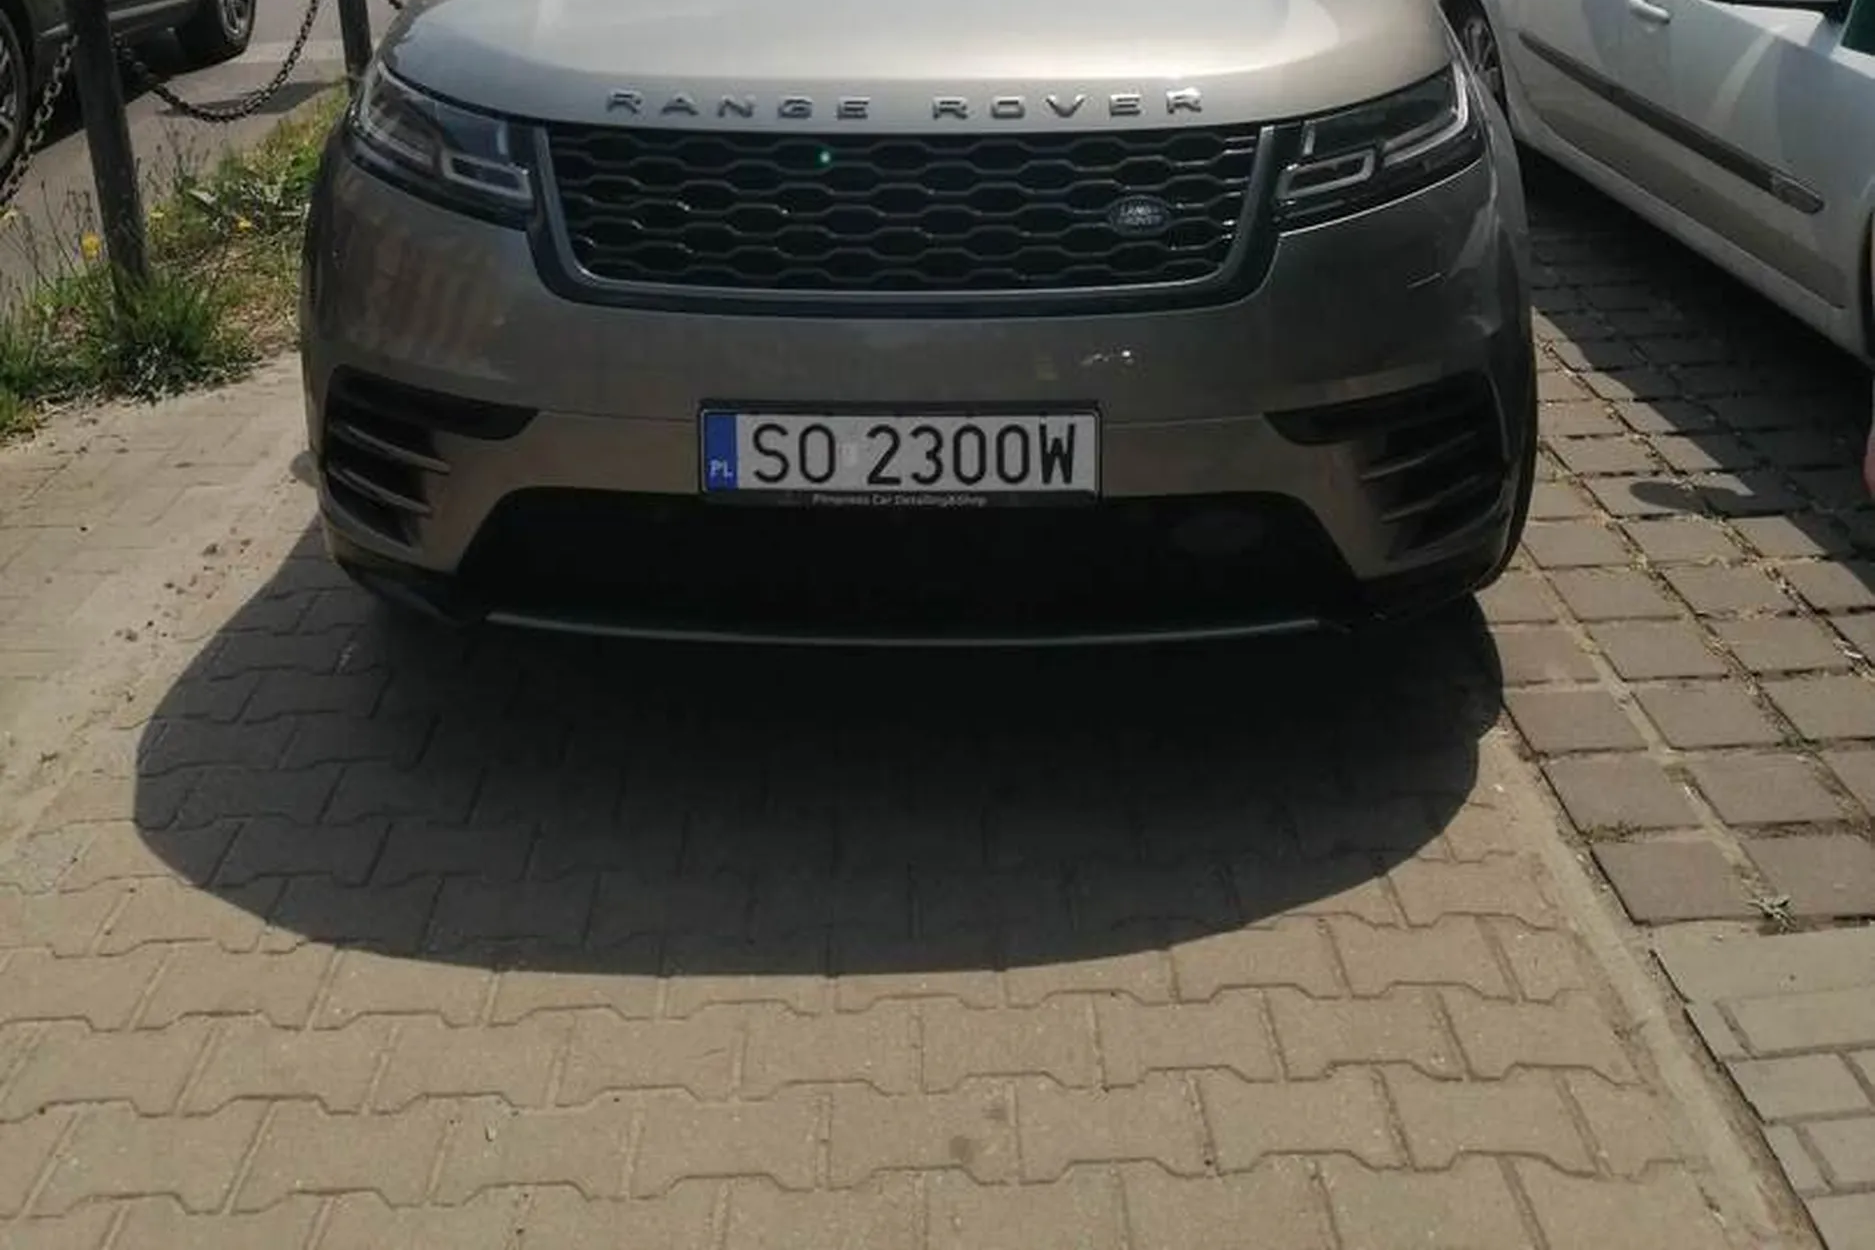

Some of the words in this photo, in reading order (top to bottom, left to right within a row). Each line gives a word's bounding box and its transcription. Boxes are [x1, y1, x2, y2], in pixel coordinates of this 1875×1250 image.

[606, 88, 871, 121] RANGE
[931, 87, 1203, 120] ROVER
[710, 459, 734, 478] PL
[752, 423, 837, 485] SO
[865, 422, 1077, 486] 2300W
